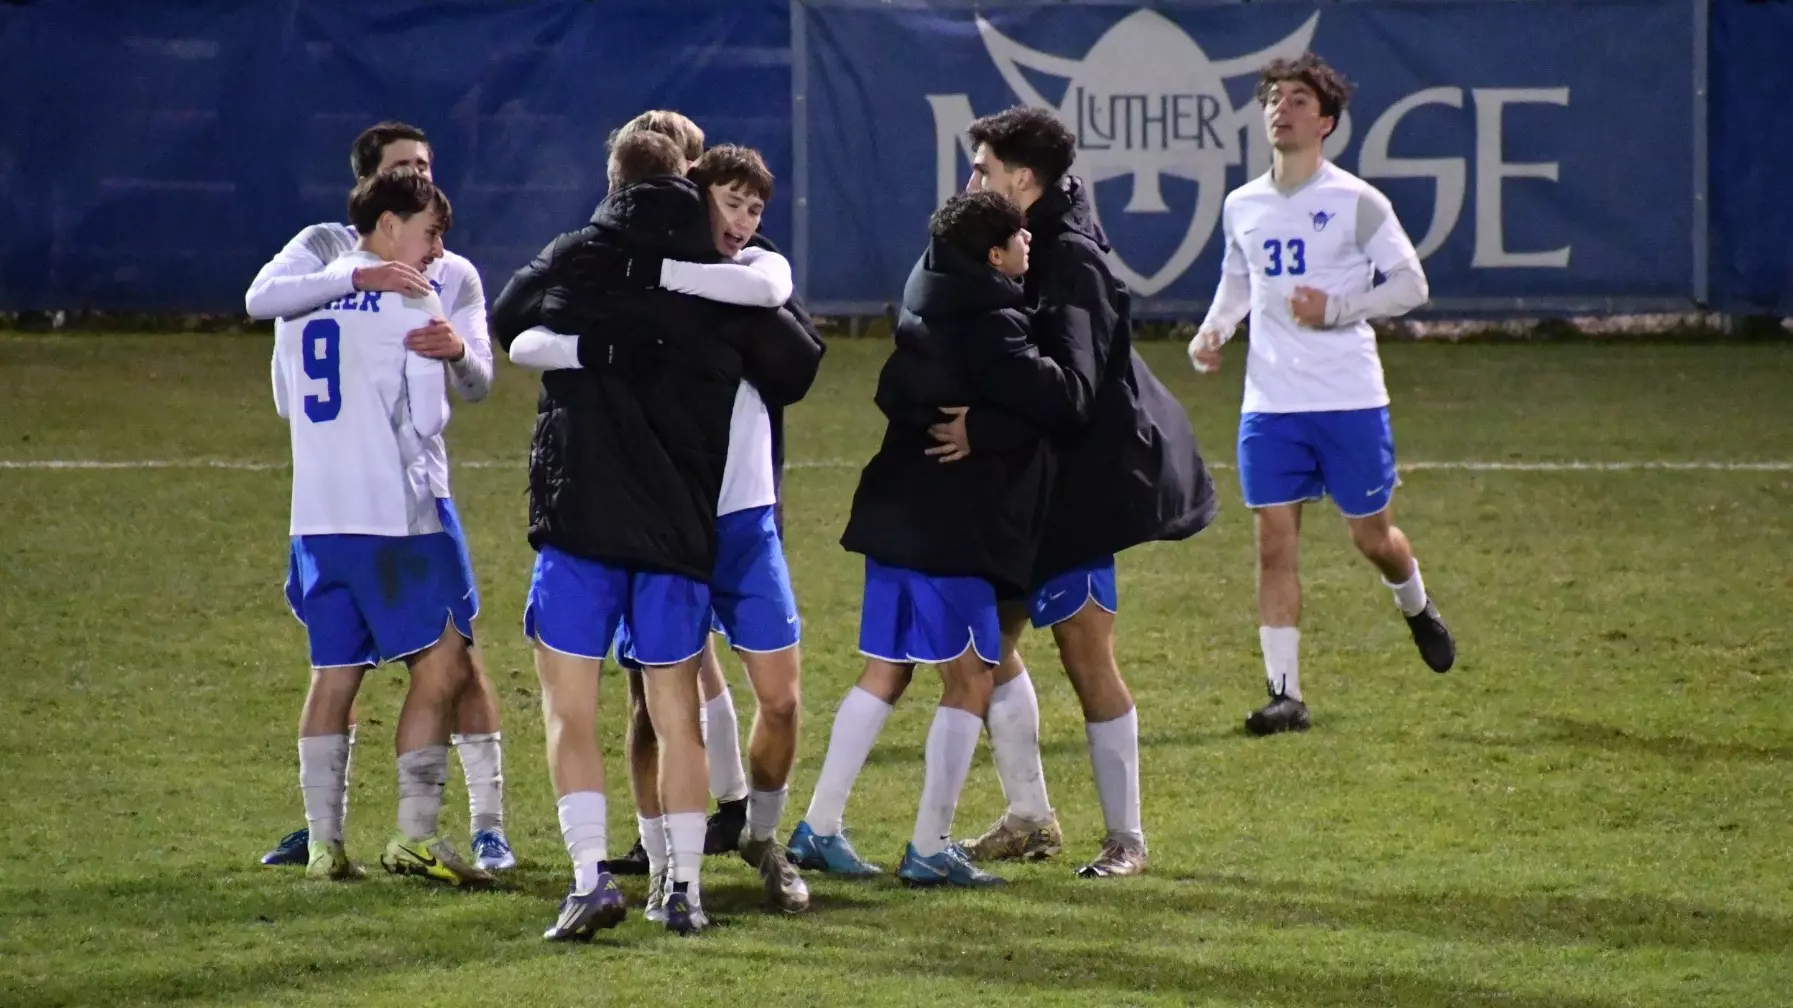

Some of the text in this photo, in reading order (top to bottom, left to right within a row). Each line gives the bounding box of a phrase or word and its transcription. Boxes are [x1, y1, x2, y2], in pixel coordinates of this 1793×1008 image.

[1076, 86, 1225, 150] LUTHER
[1262, 238, 1306, 277] 33
[302, 318, 342, 423] 9
